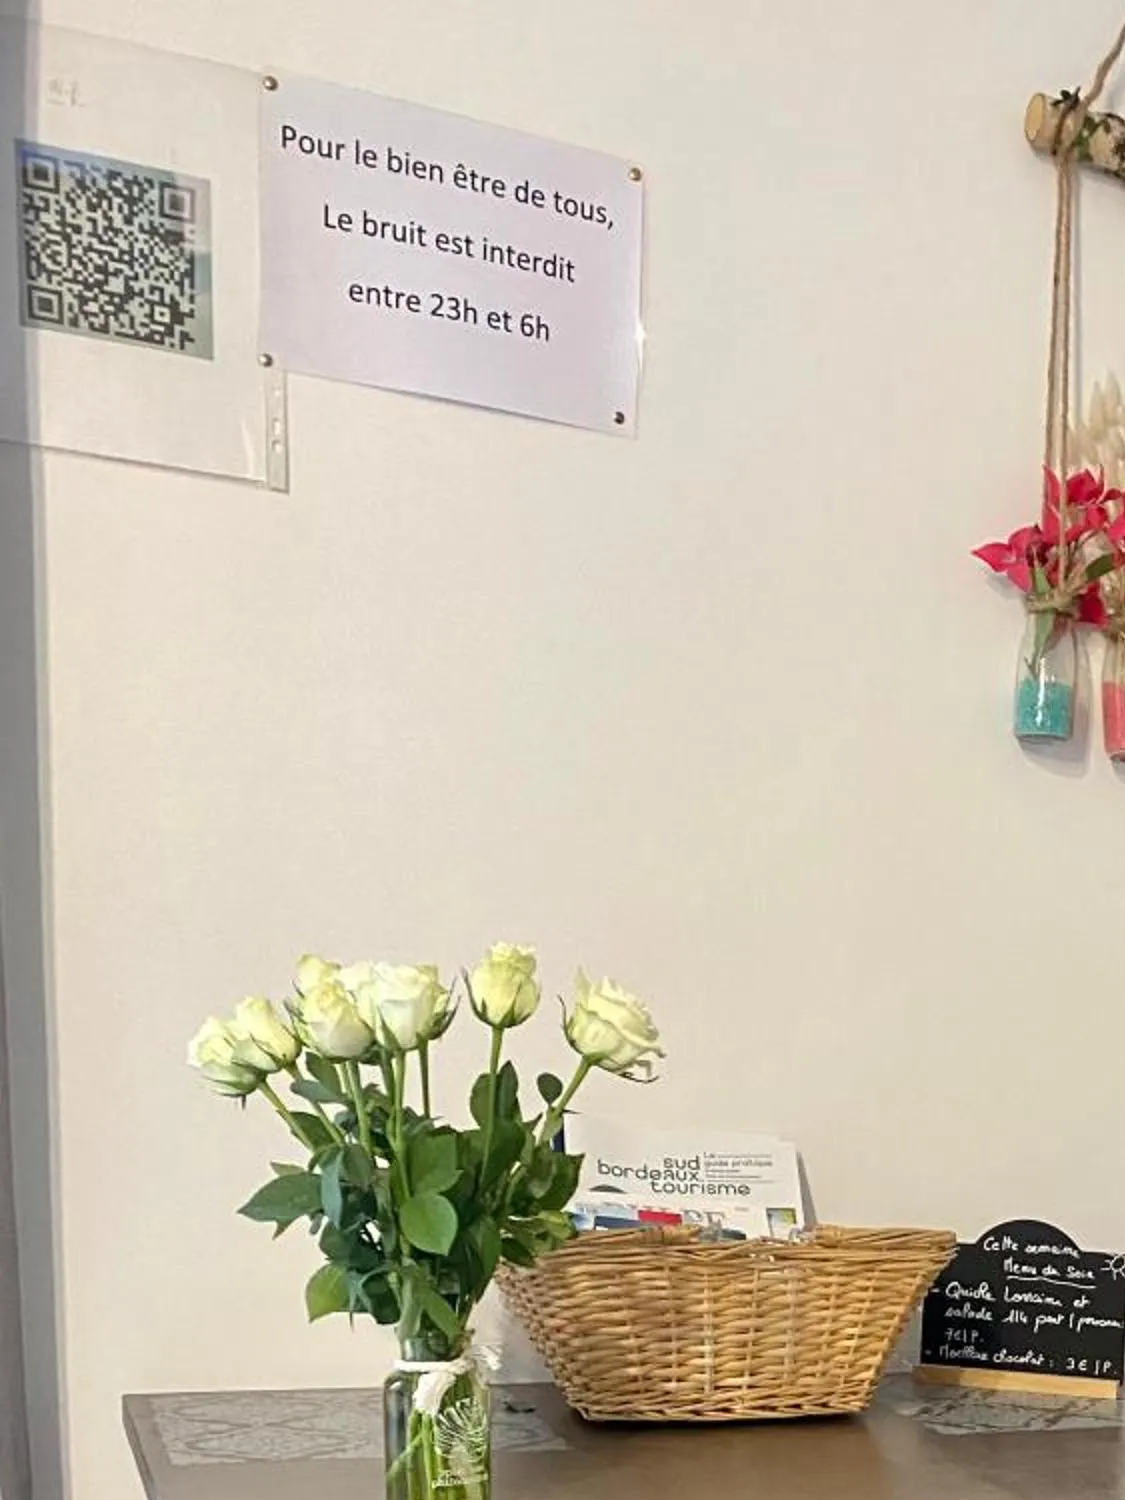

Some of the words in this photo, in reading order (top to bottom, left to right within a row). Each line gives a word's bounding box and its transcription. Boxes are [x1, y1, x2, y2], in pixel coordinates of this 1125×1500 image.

[280, 125, 347, 162] Pour
[354, 139, 378, 169] le
[386, 144, 444, 185] bien
[453, 162, 506, 199] être
[514, 180, 546, 209] de
[553, 190, 615, 229] tous,
[323, 205, 353, 232] Le
[363, 207, 427, 248] bruit
[435, 228, 474, 258] est
[482, 237, 576, 283] interdit
[348, 282, 422, 313] entre
[430, 294, 479, 325] 23h
[487, 307, 516, 333] et
[519, 313, 550, 341] 6h
[597, 1159, 700, 1182] bordeaux
[663, 1155, 700, 1171] sud
[650, 1180, 752, 1196] tourisme
[983, 1236, 1019, 1252] Cette
[1003, 1257, 1038, 1275] Menu
[945, 1281, 996, 1302] Quiche
[1073, 1295, 1091, 1309] et
